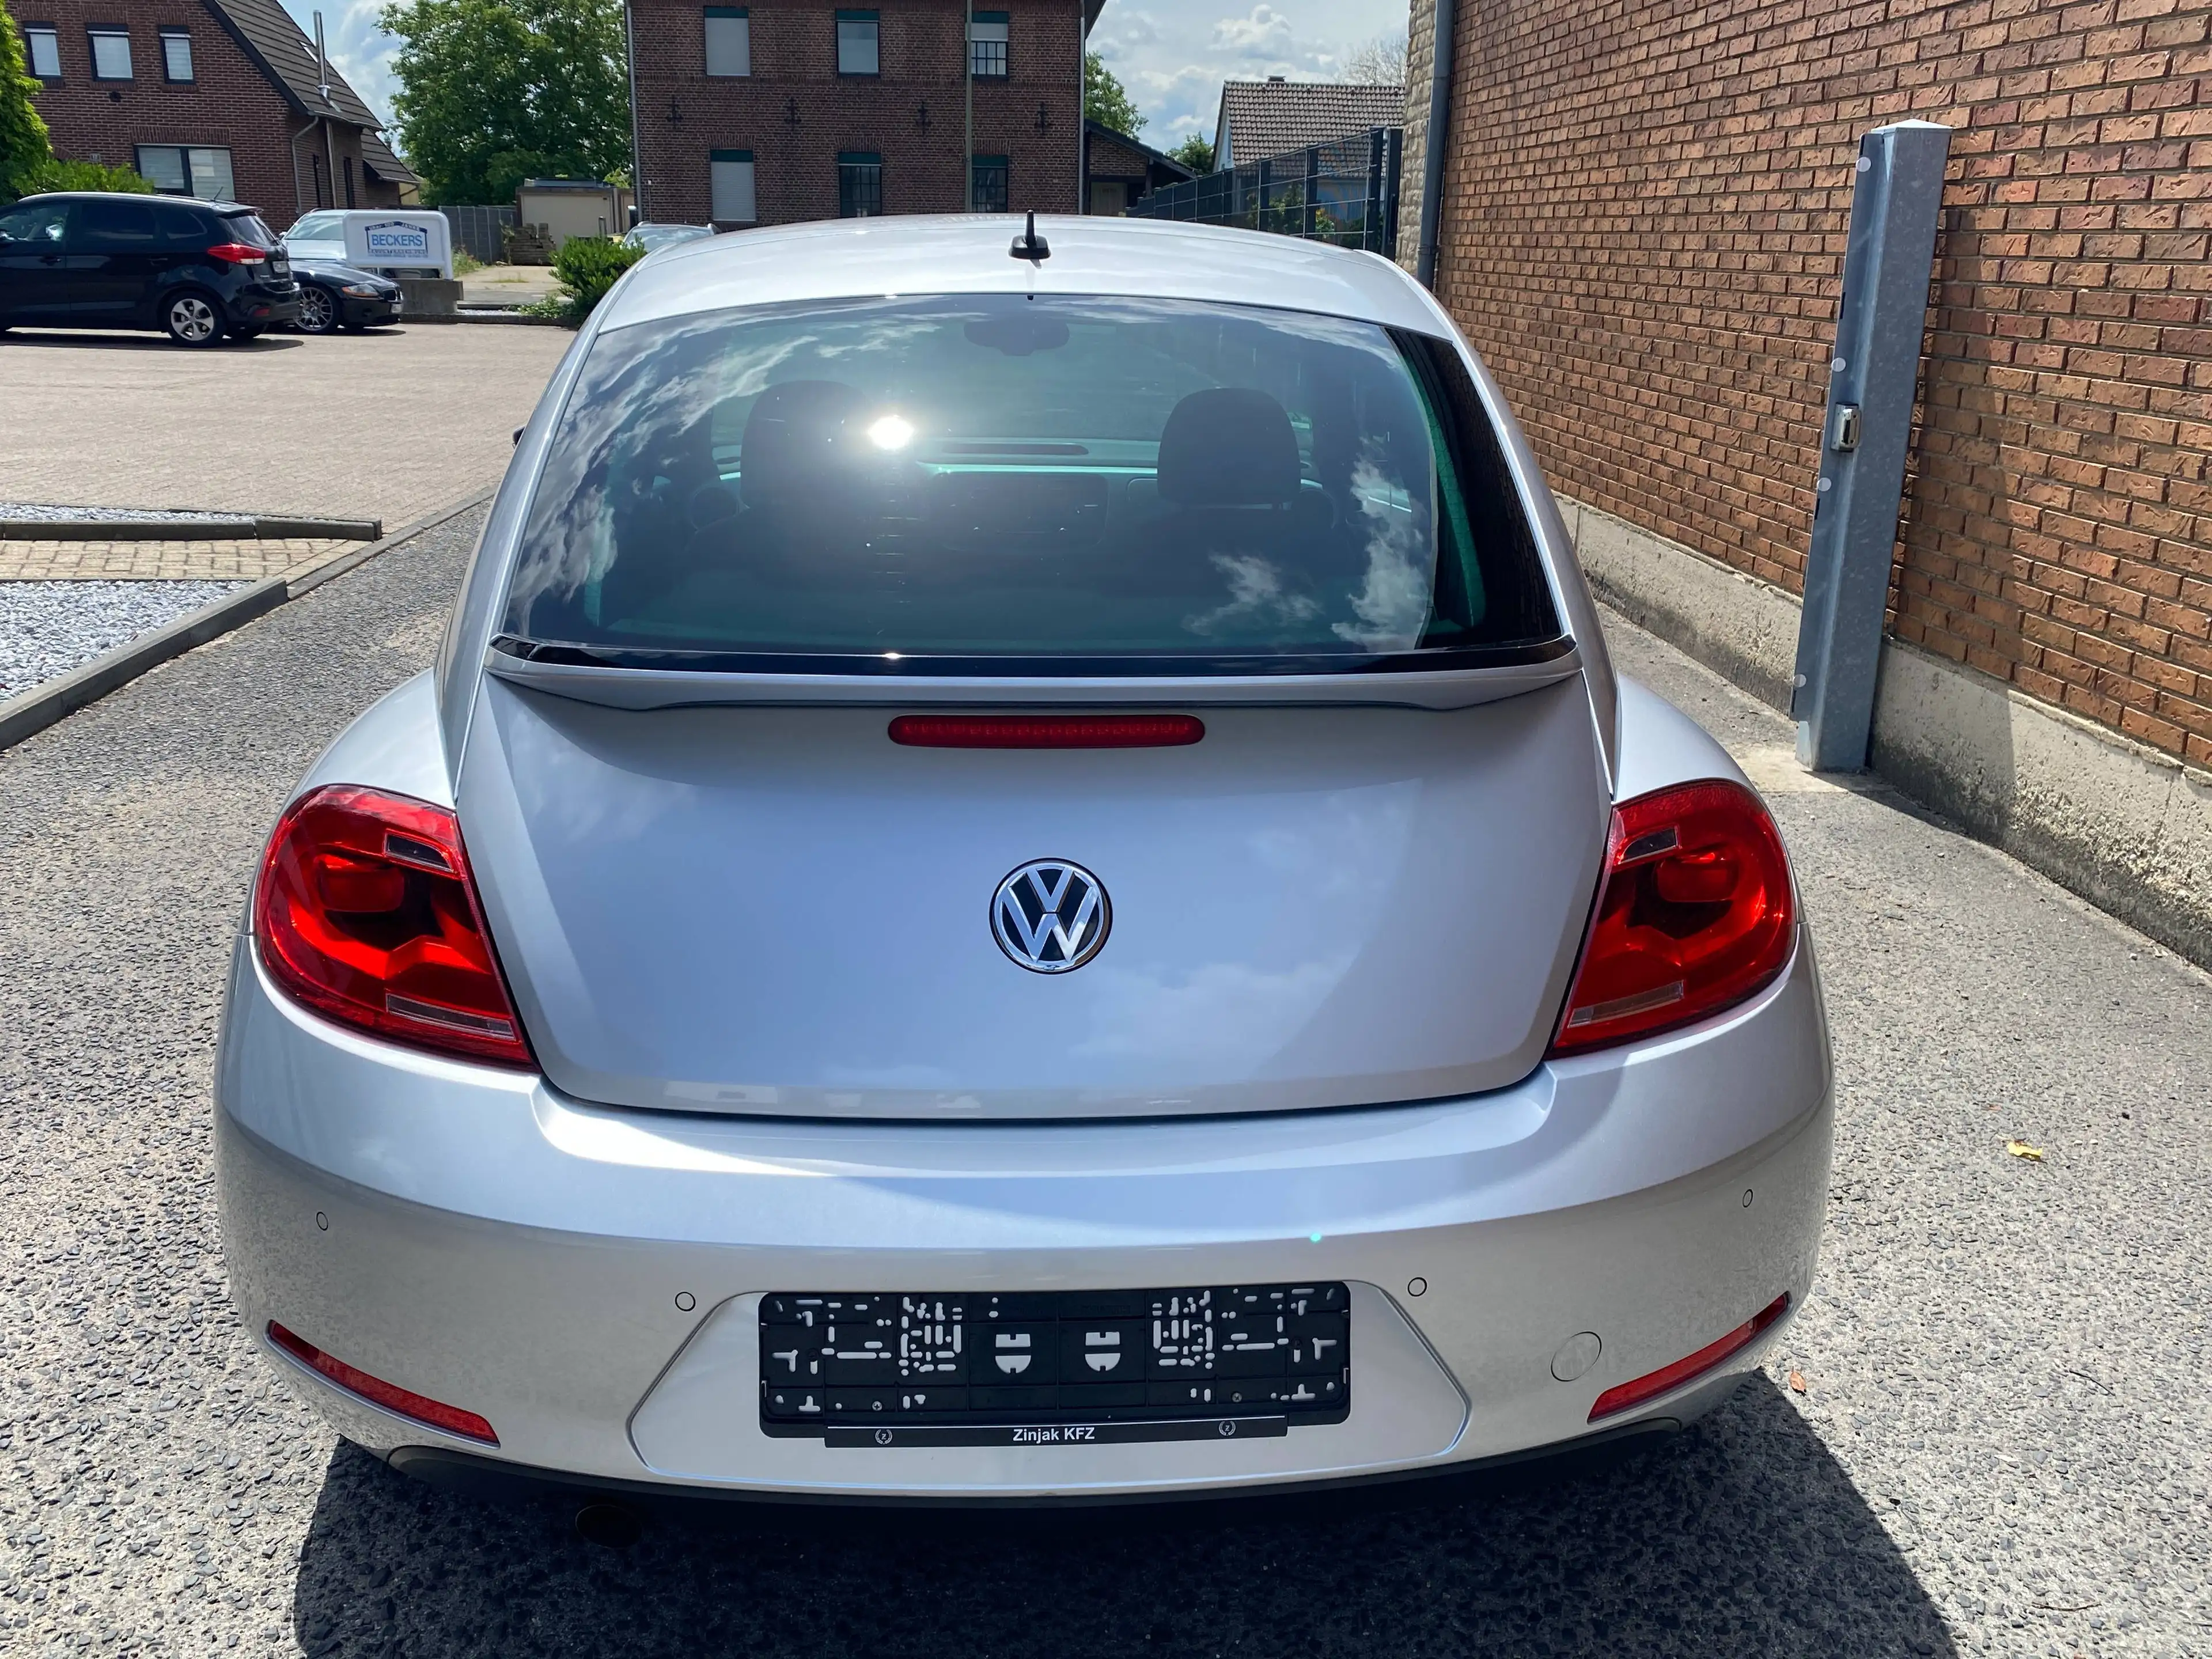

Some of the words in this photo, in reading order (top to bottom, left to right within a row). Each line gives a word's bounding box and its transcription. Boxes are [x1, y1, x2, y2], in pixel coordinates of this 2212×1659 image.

[371, 234, 423, 247] BECKERS
[1013, 1428, 1059, 1444] Zinjak
[1064, 1427, 1095, 1440] KFZ
